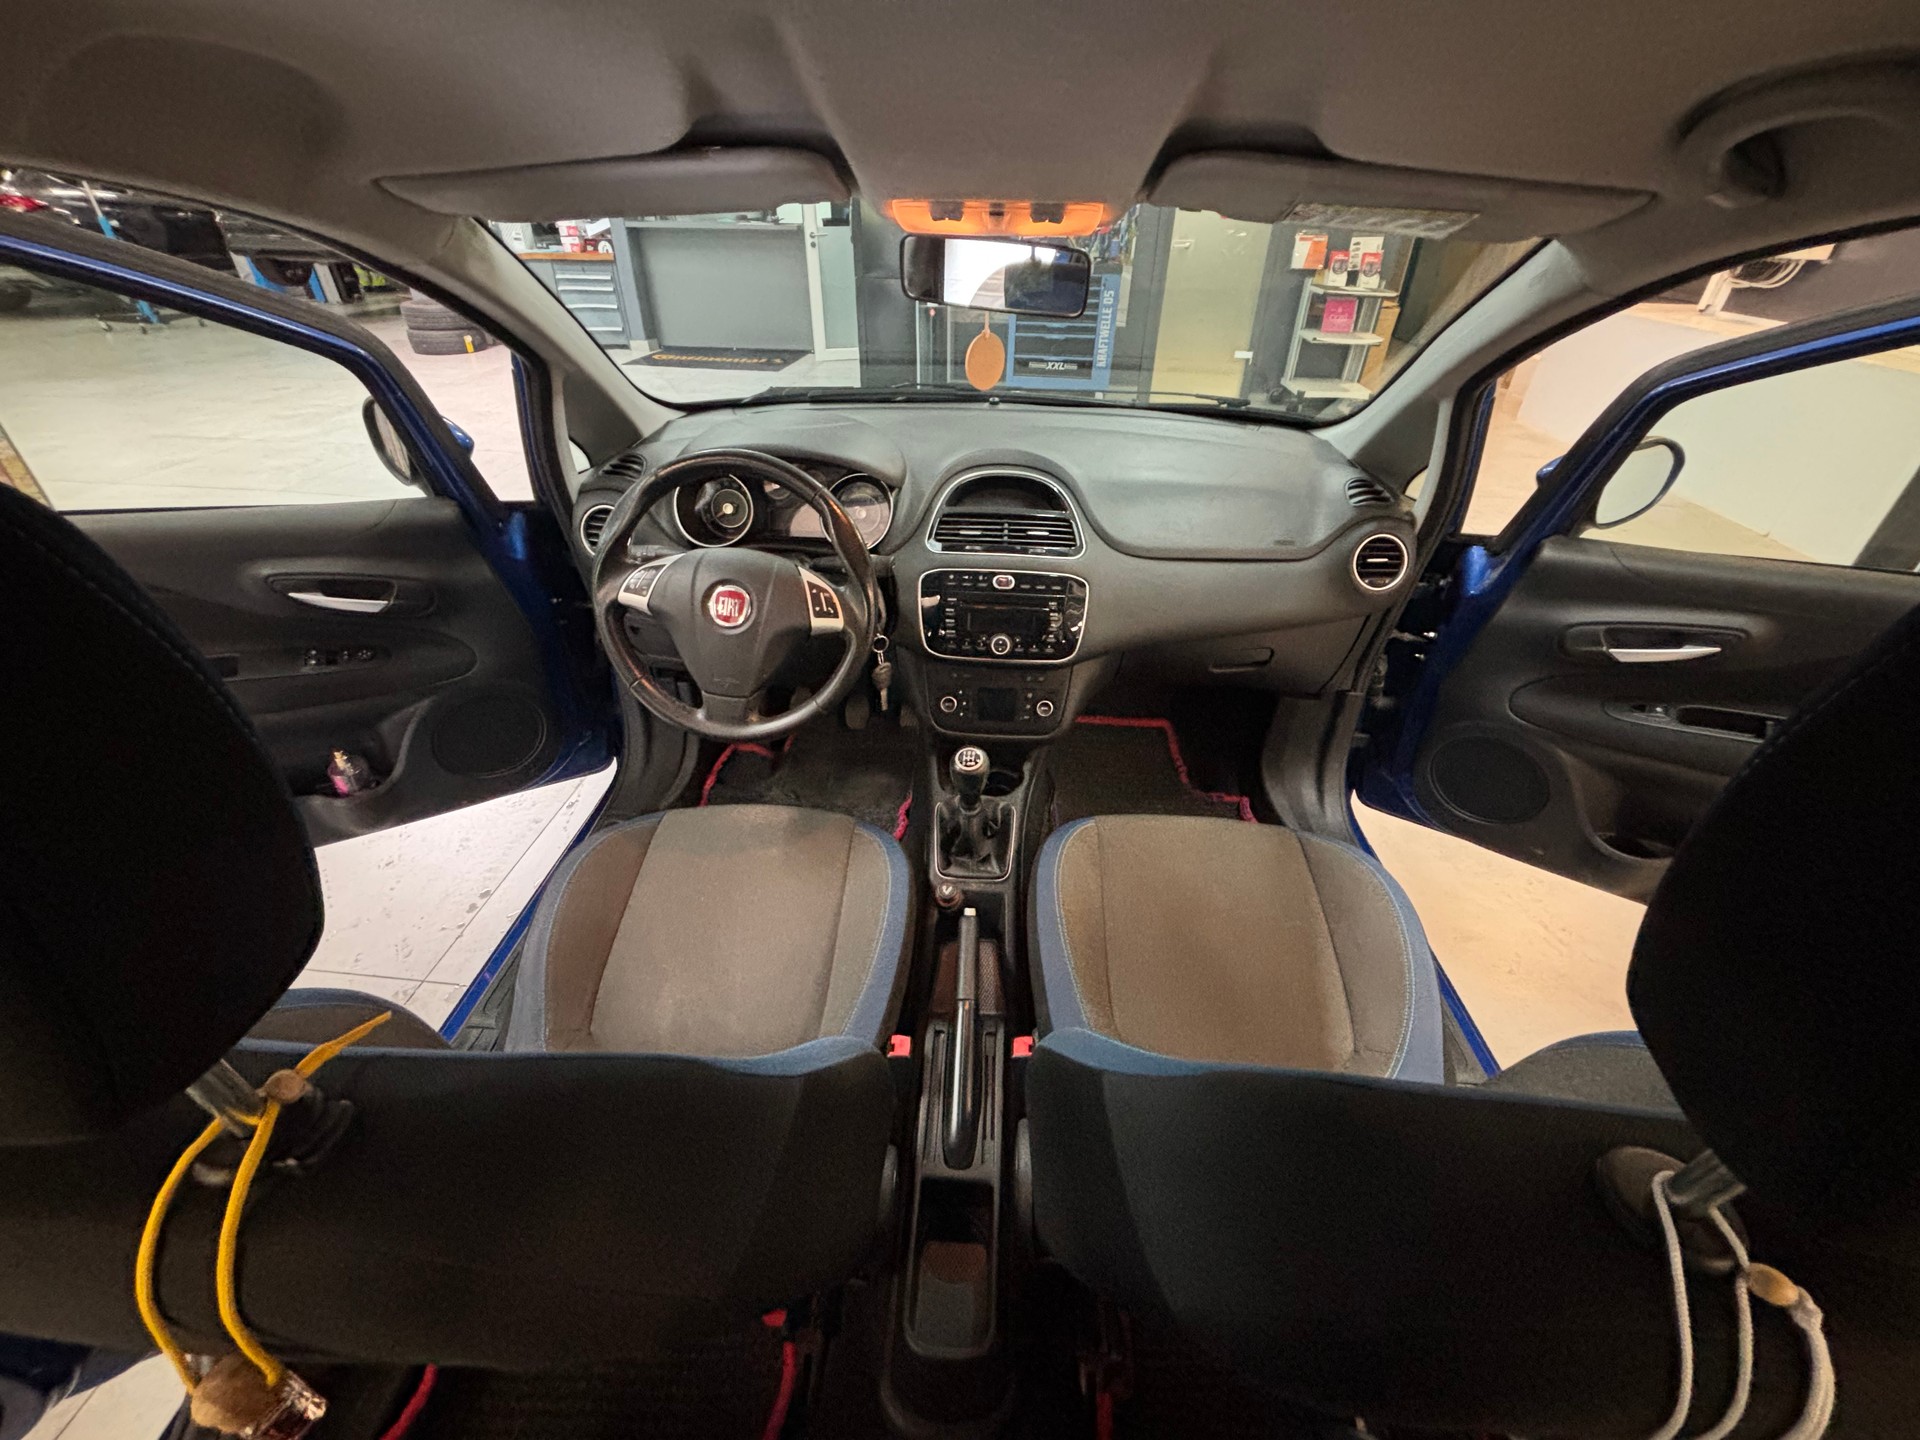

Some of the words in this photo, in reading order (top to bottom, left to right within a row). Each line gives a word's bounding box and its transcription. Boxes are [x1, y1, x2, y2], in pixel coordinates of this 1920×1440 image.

[1096, 307, 1112, 368] KRAFTWELLE
[1046, 361, 1066, 371] XXL
[717, 596, 742, 617] FIAT
